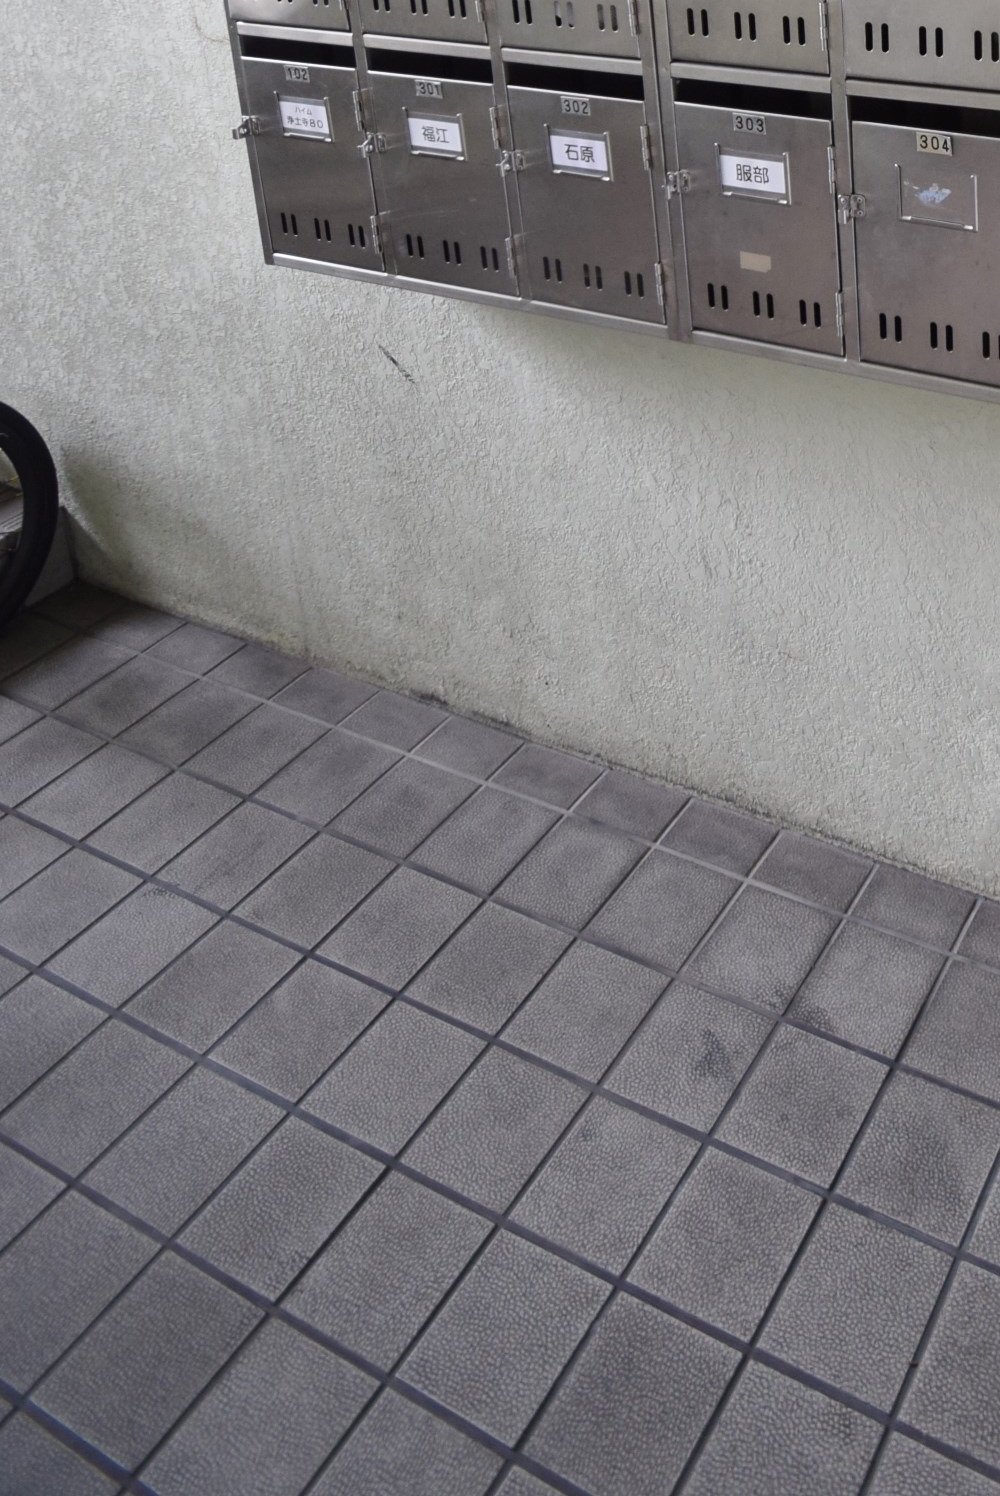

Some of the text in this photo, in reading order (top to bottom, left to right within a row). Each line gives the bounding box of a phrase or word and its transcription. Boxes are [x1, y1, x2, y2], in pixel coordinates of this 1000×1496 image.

[287, 67, 308, 81] 102
[419, 82, 440, 96] 301
[563, 99, 589, 115] 302
[735, 115, 764, 133] 303
[421, 125, 450, 144] 福江
[919, 134, 950, 152] 304
[564, 143, 595, 163] 石原
[736, 163, 770, 184] 服部
